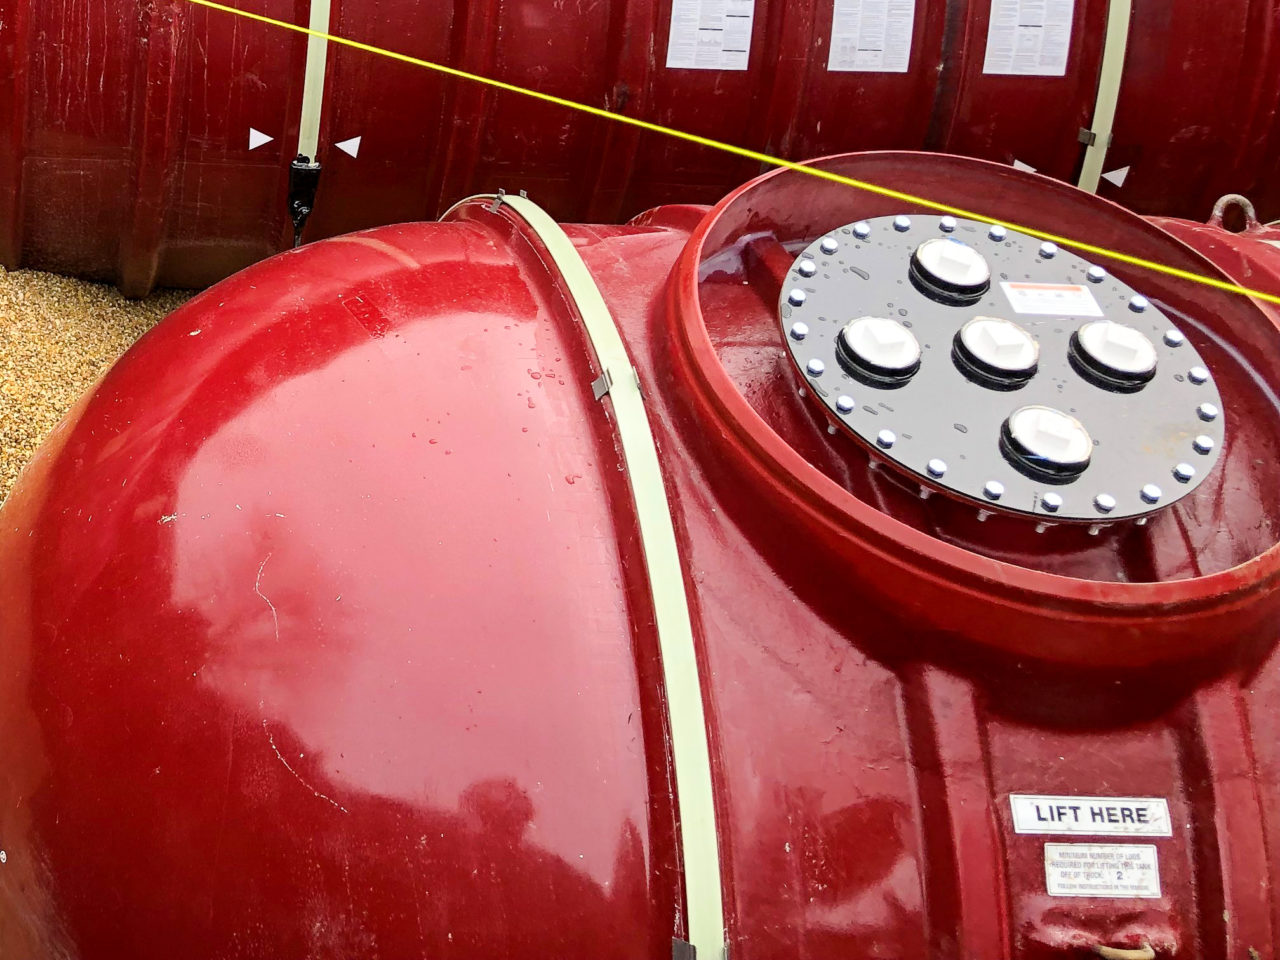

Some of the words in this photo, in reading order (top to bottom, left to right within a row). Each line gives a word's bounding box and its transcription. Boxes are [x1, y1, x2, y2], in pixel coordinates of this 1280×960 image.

[1036, 805, 1081, 822] LIFT
[1090, 806, 1150, 824] HERE
[1116, 871, 1124, 880] 2
